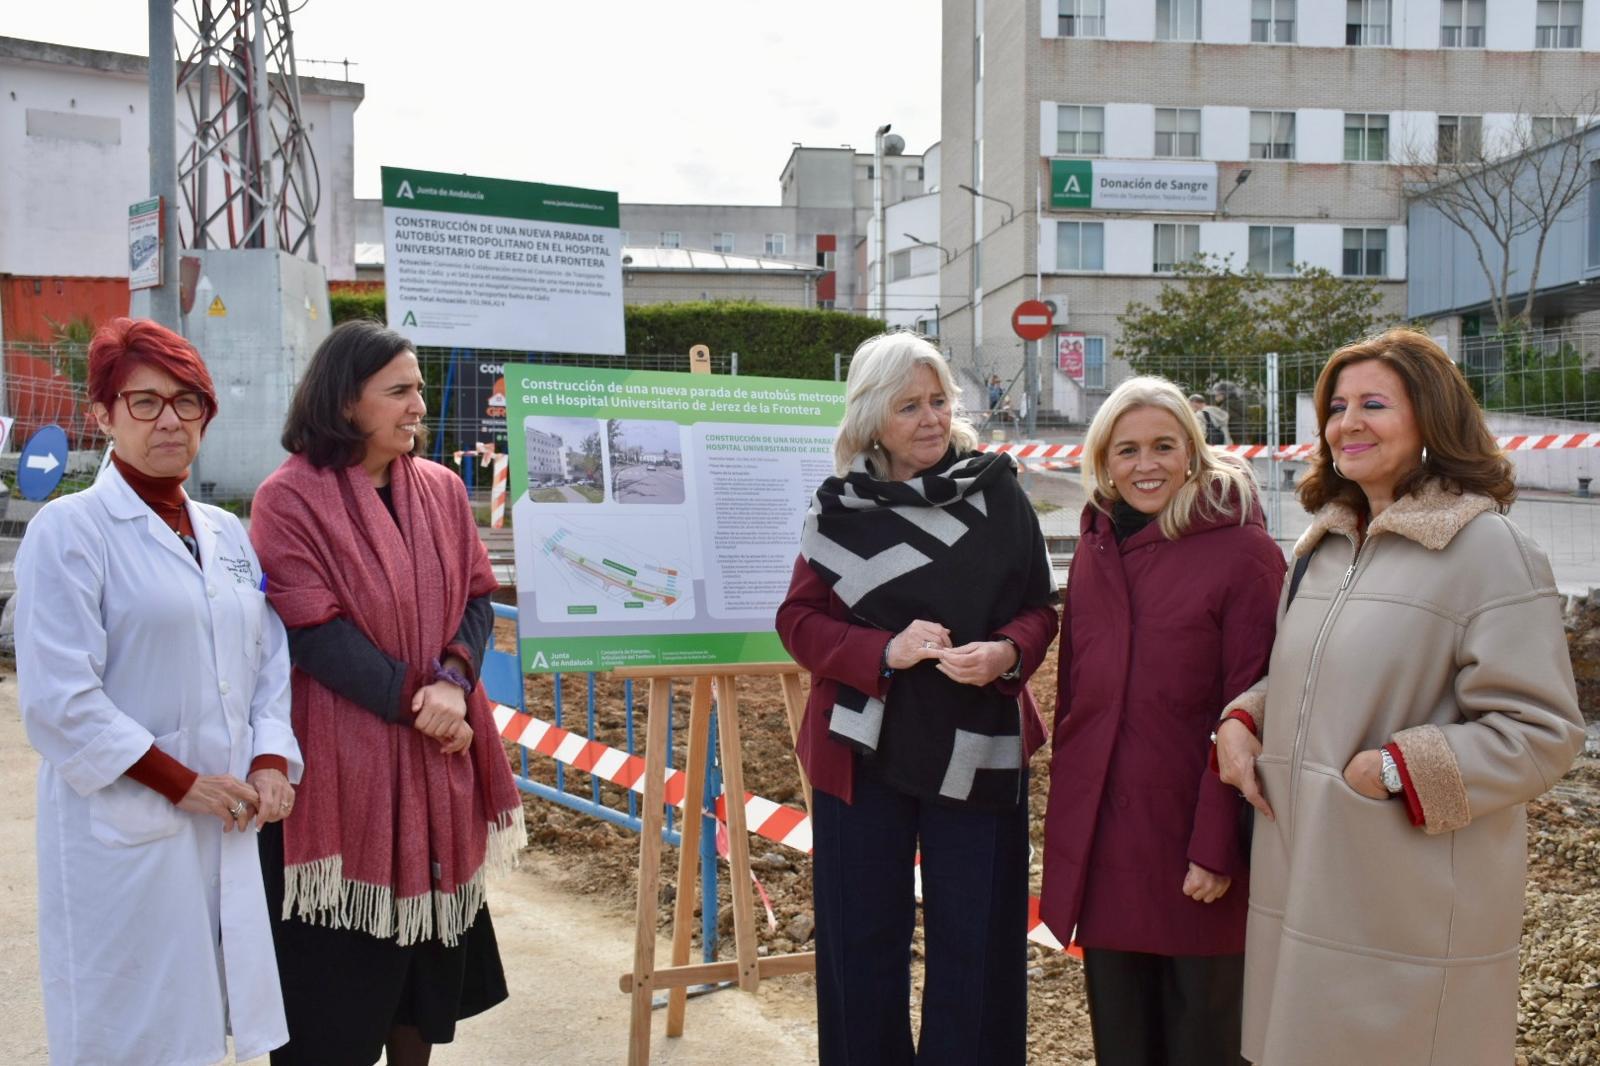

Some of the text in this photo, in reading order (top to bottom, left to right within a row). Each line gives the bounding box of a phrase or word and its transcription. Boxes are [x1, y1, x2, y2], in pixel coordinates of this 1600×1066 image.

[417, 186, 484, 200] Junta de Andalucía
[1100, 178, 1208, 193] Donación de Sangre
[395, 216, 604, 243] CONSTRUCCIÓN DE UNA NUEVA PARADA DE
[395, 230, 610, 256] AUTOBÚS METROPOLITANO EN EL HOSPITAL
[395, 244, 605, 268] UNIVERSITARIO DE JEREZ DE LA FRONTERA
[521, 378, 847, 405] Construcción de una nueva parada de autobús metropo
[522, 394, 821, 416] en el Hospital Universitario de Jerez de la Frontera
[705, 434, 760, 442] CONSTRUCCIÓN
